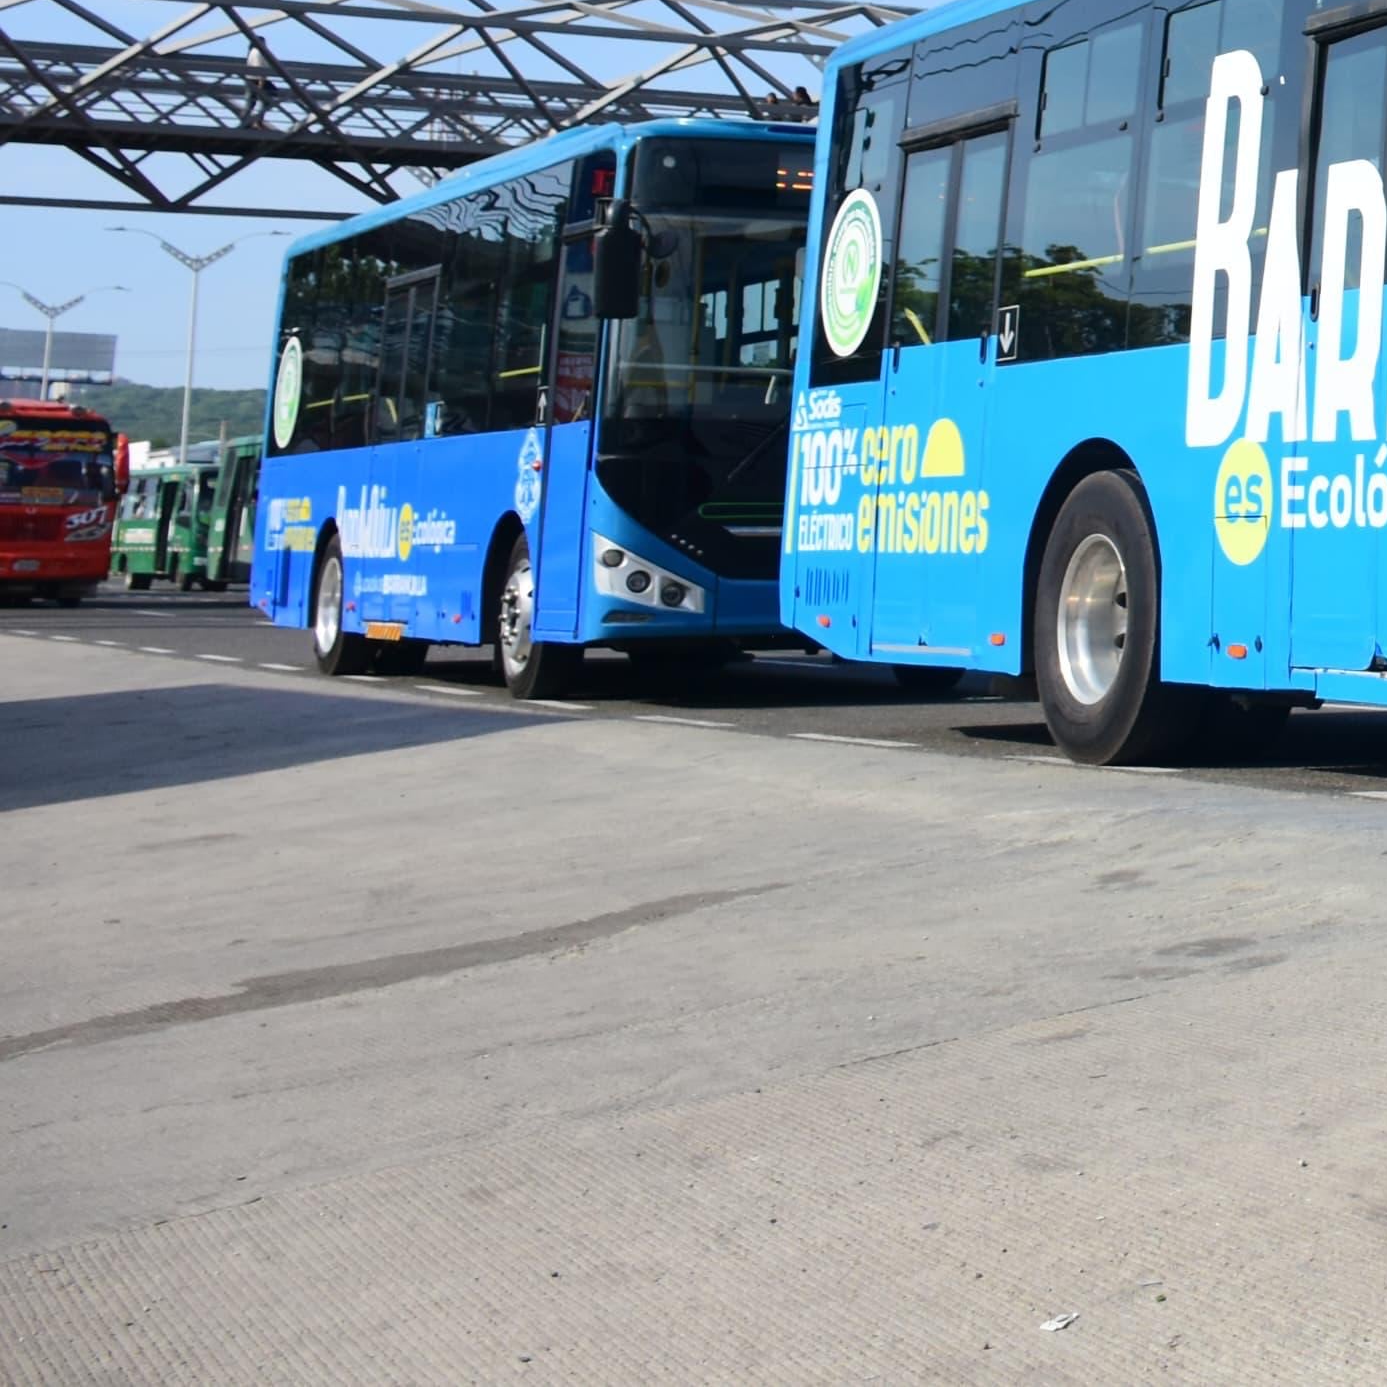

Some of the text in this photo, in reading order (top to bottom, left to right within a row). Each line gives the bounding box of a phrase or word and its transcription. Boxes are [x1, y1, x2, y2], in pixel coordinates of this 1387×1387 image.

[800, 428, 859, 507] 100%
[860, 421, 920, 488] cero
[797, 508, 855, 552] ELÉCTRICO
[857, 488, 991, 556] emisiones
[1223, 473, 1264, 524] es
